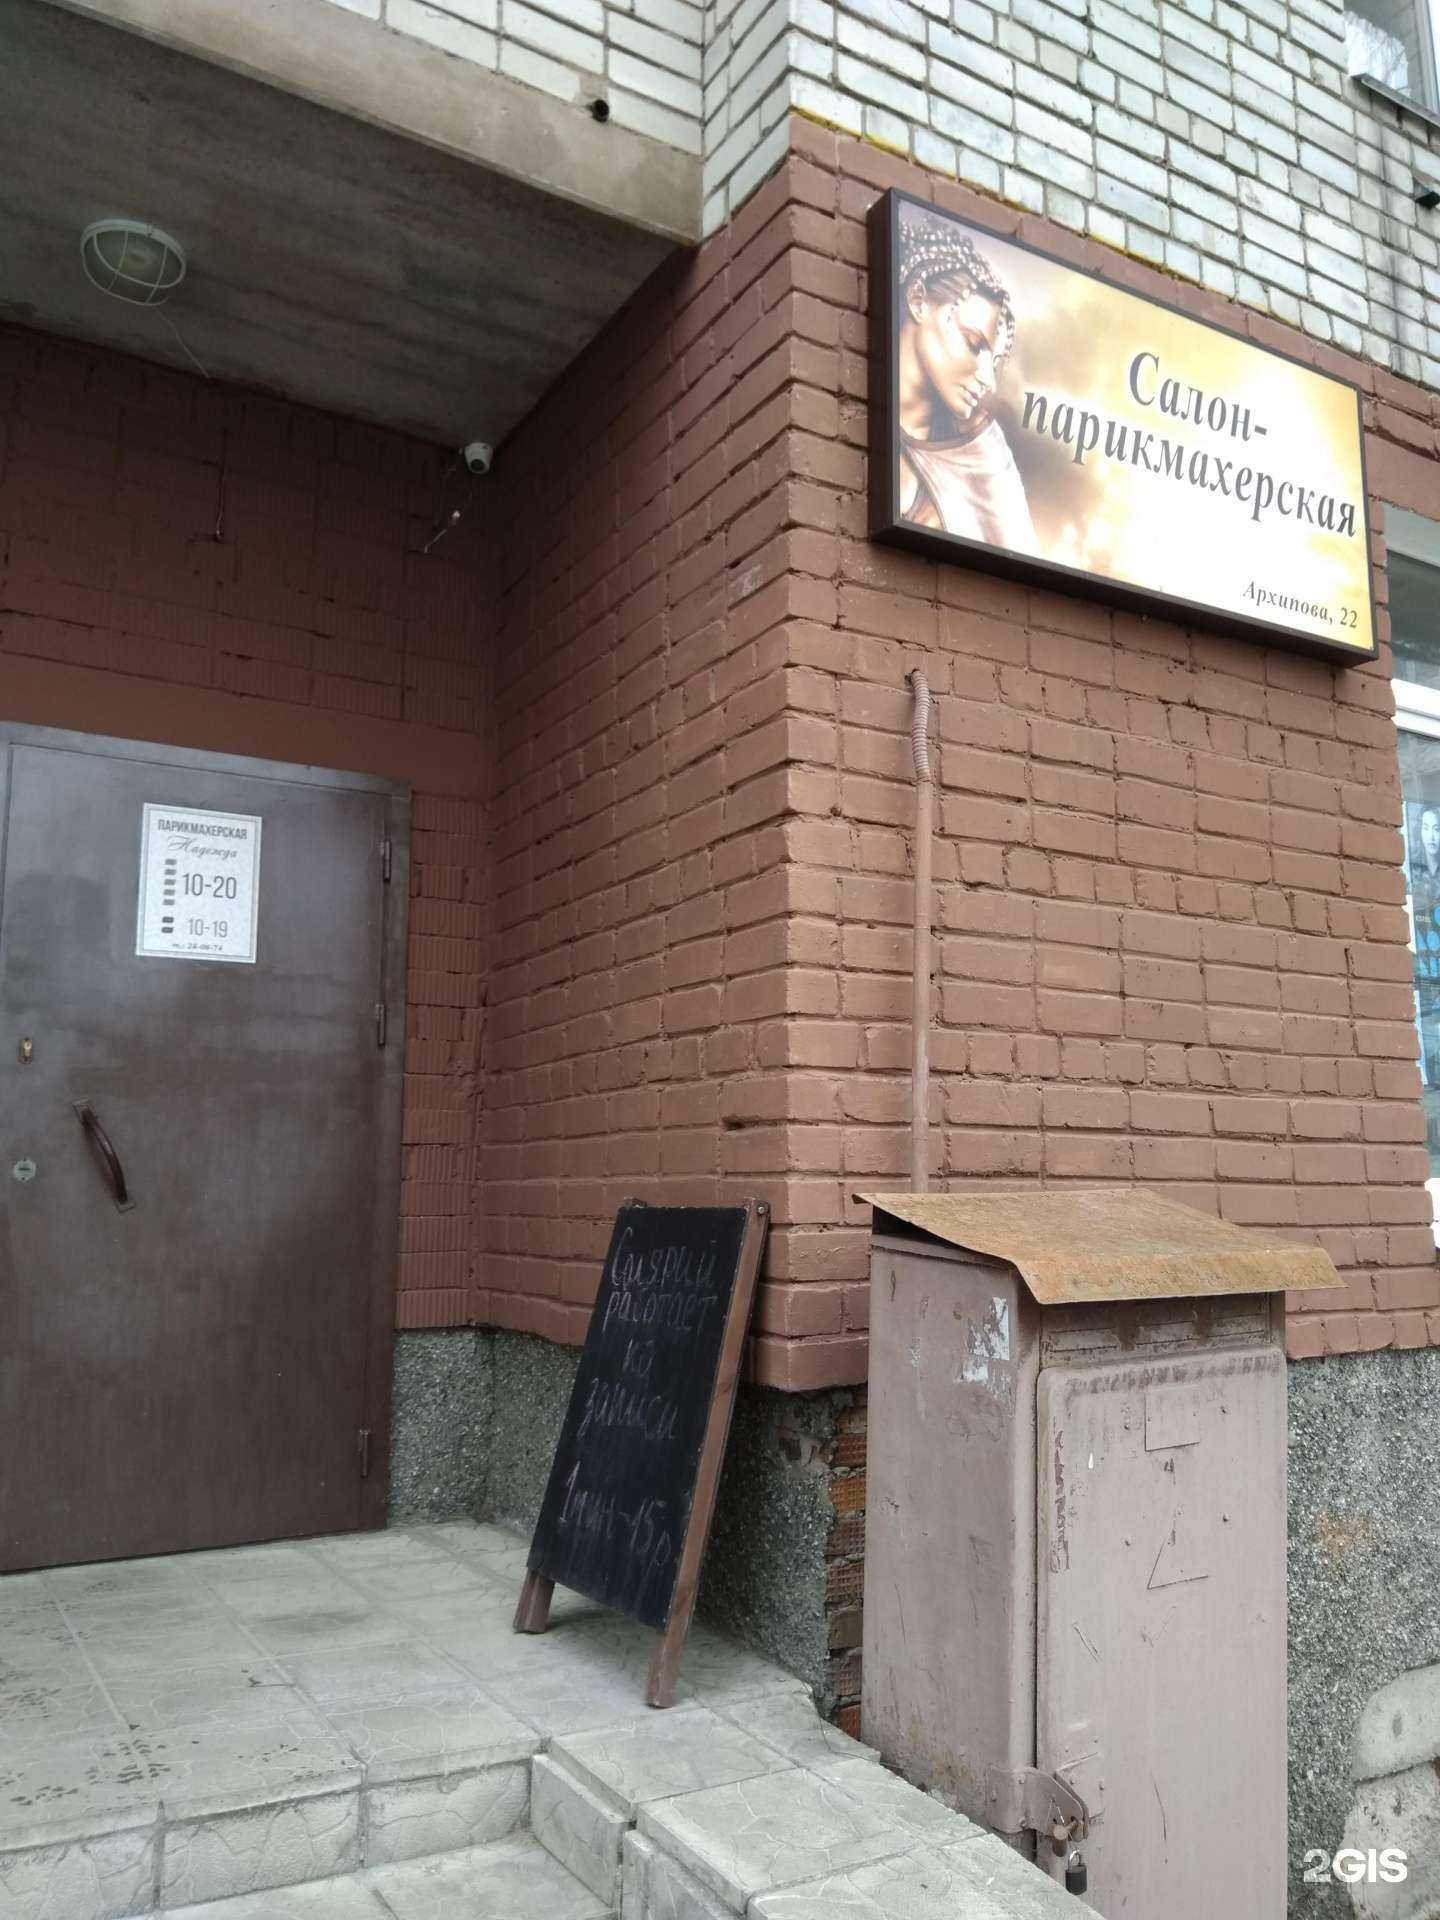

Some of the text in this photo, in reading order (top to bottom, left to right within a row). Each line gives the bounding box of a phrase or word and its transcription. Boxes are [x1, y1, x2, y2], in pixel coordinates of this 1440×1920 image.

[1129, 351, 1268, 442] Салон-
[1021, 391, 1356, 537] парикмахерская
[1242, 580, 1358, 629] Архипова, 22
[158, 819, 248, 840] ПАРИКМАХЕРСКАЯ
[182, 873, 237, 899] 10-20
[188, 918, 228, 938] 10-19
